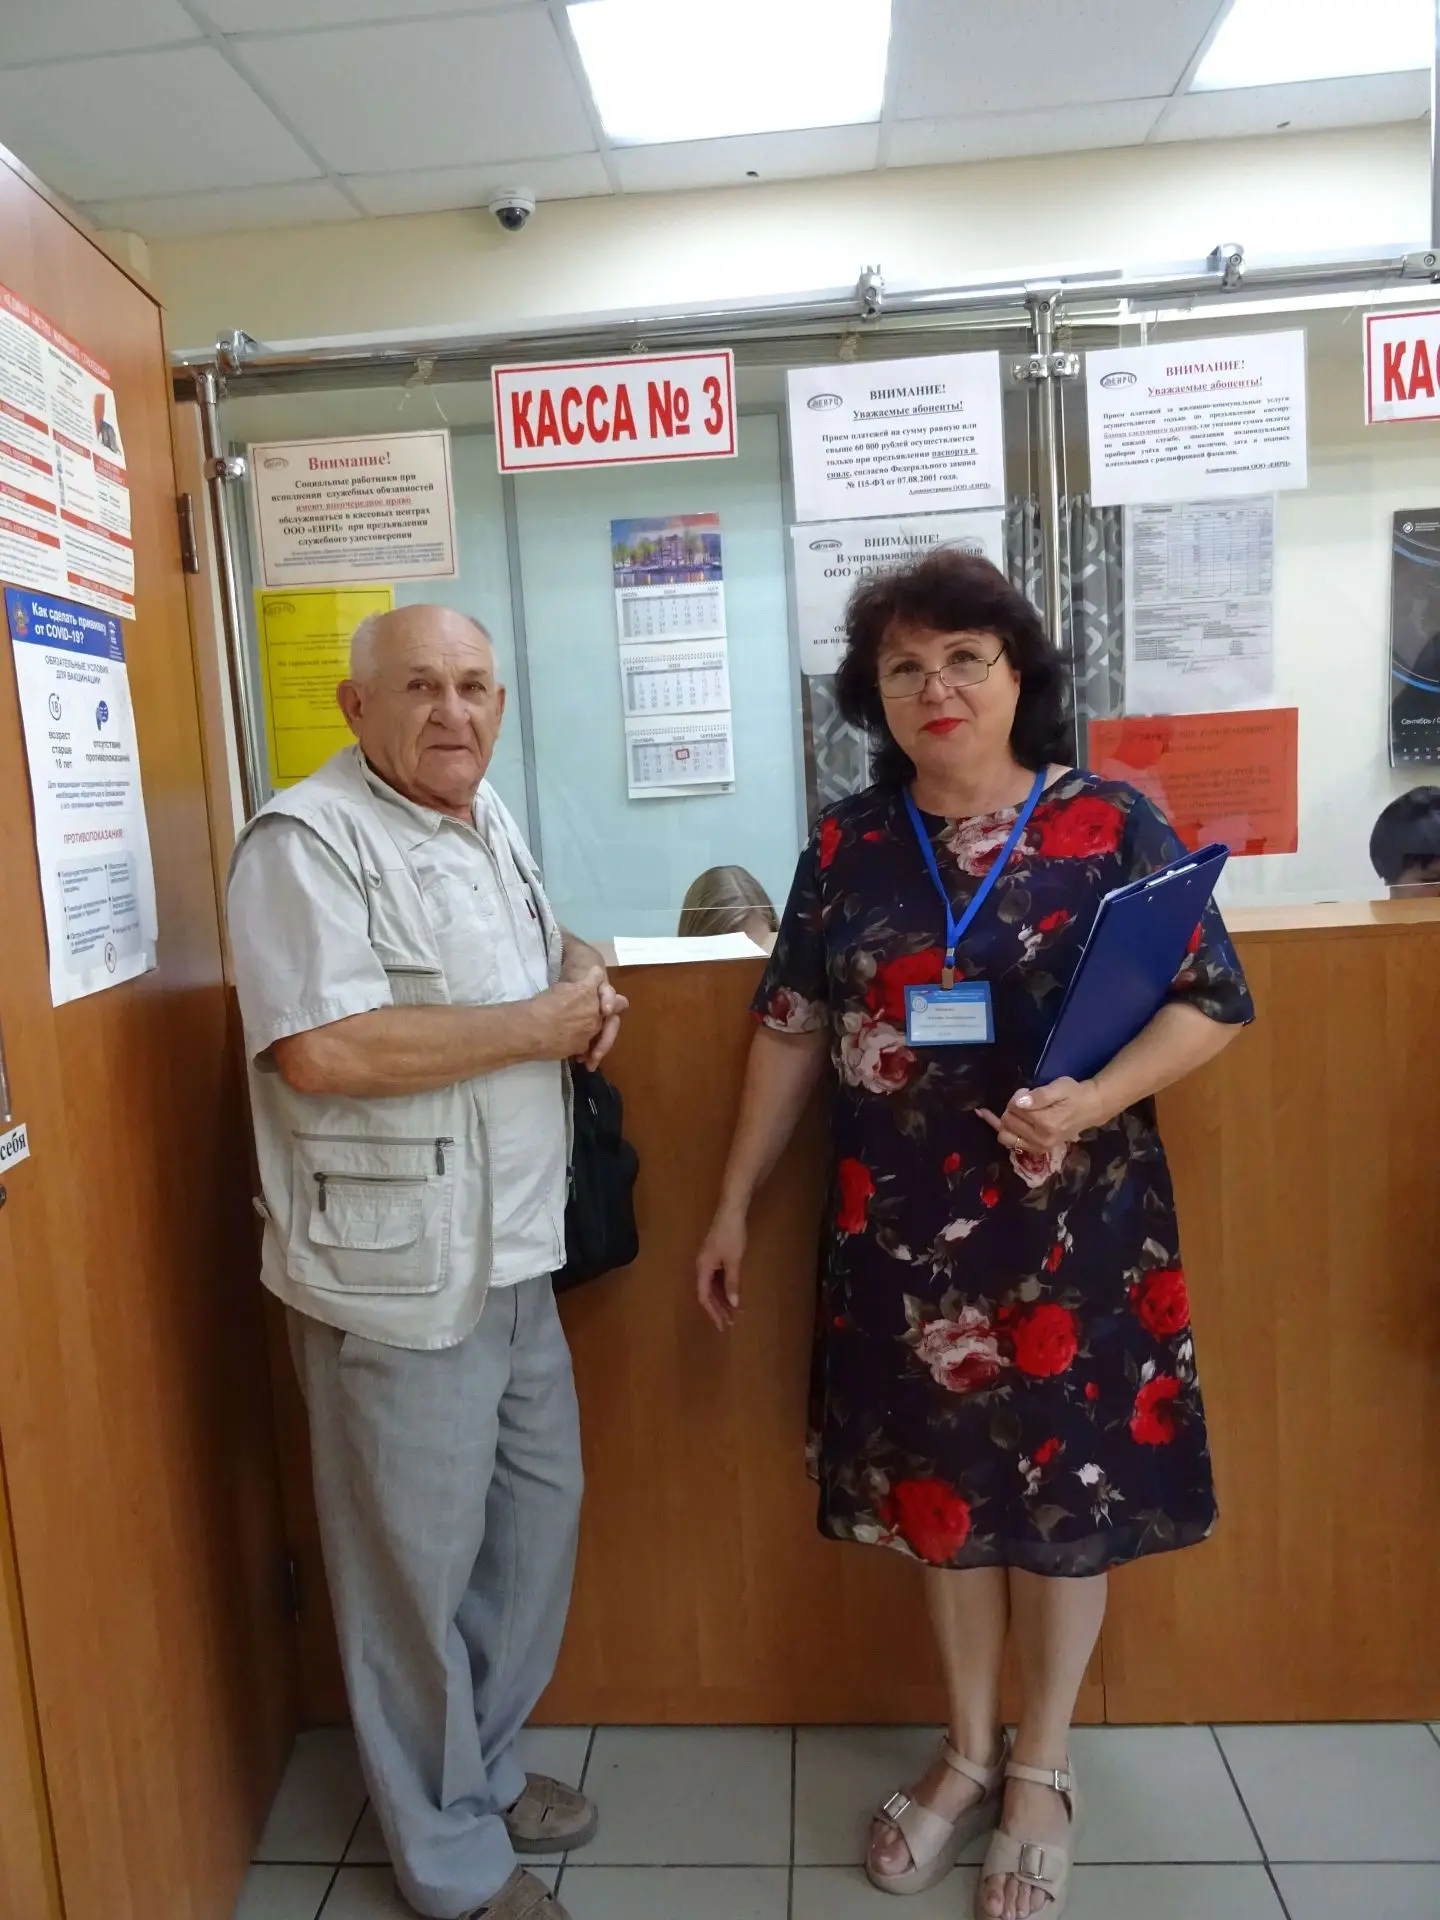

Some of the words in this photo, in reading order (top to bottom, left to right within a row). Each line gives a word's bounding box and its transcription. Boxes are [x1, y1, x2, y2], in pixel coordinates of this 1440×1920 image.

[1166, 359, 1245, 377] ВНИМАНИЕ!
[1383, 339, 1440, 402] КА
[870, 384, 947, 401] ВНИМАНИЕ!
[1147, 382, 1208, 397] Уважаемые
[1210, 376, 1263, 391] абоненты!
[1267, 396, 1290, 404] услуги
[511, 383, 638, 448] КАССА
[647, 380, 691, 439] №
[702, 375, 724, 435] 3
[852, 405, 910, 422] Уважаемые
[912, 400, 963, 415] абоненты!
[1103, 419, 1156, 430] осуществляется
[1209, 409, 1256, 419] предъявлении
[1263, 406, 1290, 414] кассиру
[851, 430, 889, 440] платежей
[902, 427, 927, 437] сумму
[929, 423, 960, 434] равную
[825, 446, 853, 454] свыше
[854, 443, 864, 451] 60
[865, 442, 880, 450] 000
[881, 439, 909, 451] рублей
[910, 435, 975, 448] осуществляется
[308, 450, 391, 471] Внимание!
[826, 458, 854, 466] только
[855, 456, 871, 465] при
[872, 451, 930, 464] предъявлении
[931, 448, 969, 459] паспорта
[1250, 462, 1266, 470] ООО
[853, 466, 889, 477] согласно
[890, 462, 948, 473] Федерального
[949, 459, 976, 468] закона
[294, 477, 350, 490] Социальные
[351, 474, 398, 487] работники
[399, 473, 417, 484] при
[846, 480, 855, 489] №
[857, 477, 885, 488] 115-ФЗ
[897, 473, 937, 485] 07.08.2001
[952, 483, 968, 491] ООО
[271, 491, 322, 502] исполнении
[326, 485, 375, 499] служебных
[376, 483, 434, 495] обязанностей
[278, 513, 344, 525] обслуживаться
[353, 509, 394, 519] кассовых
[395, 507, 431, 518] центрах
[283, 525, 306, 536] ООО
[347, 522, 364, 532] при
[366, 519, 428, 532] предъявлении
[298, 535, 348, 547] служебного
[348, 532, 412, 544] удостоверения
[863, 533, 940, 548] ВНИМАНИЕ!
[836, 553, 844, 564] В
[823, 567, 851, 579] ООО
[31, 601, 48, 619] Как
[49, 607, 77, 626] сделать
[34, 623, 45, 636] от
[46, 623, 85, 645] COVID-19?
[44, 654, 86, 672] ОБЯЗАТЕЛЬНЫЕ
[51, 745, 73, 757] старше
[55, 758, 63, 769] 18
[0, 1131, 26, 1161] себя
